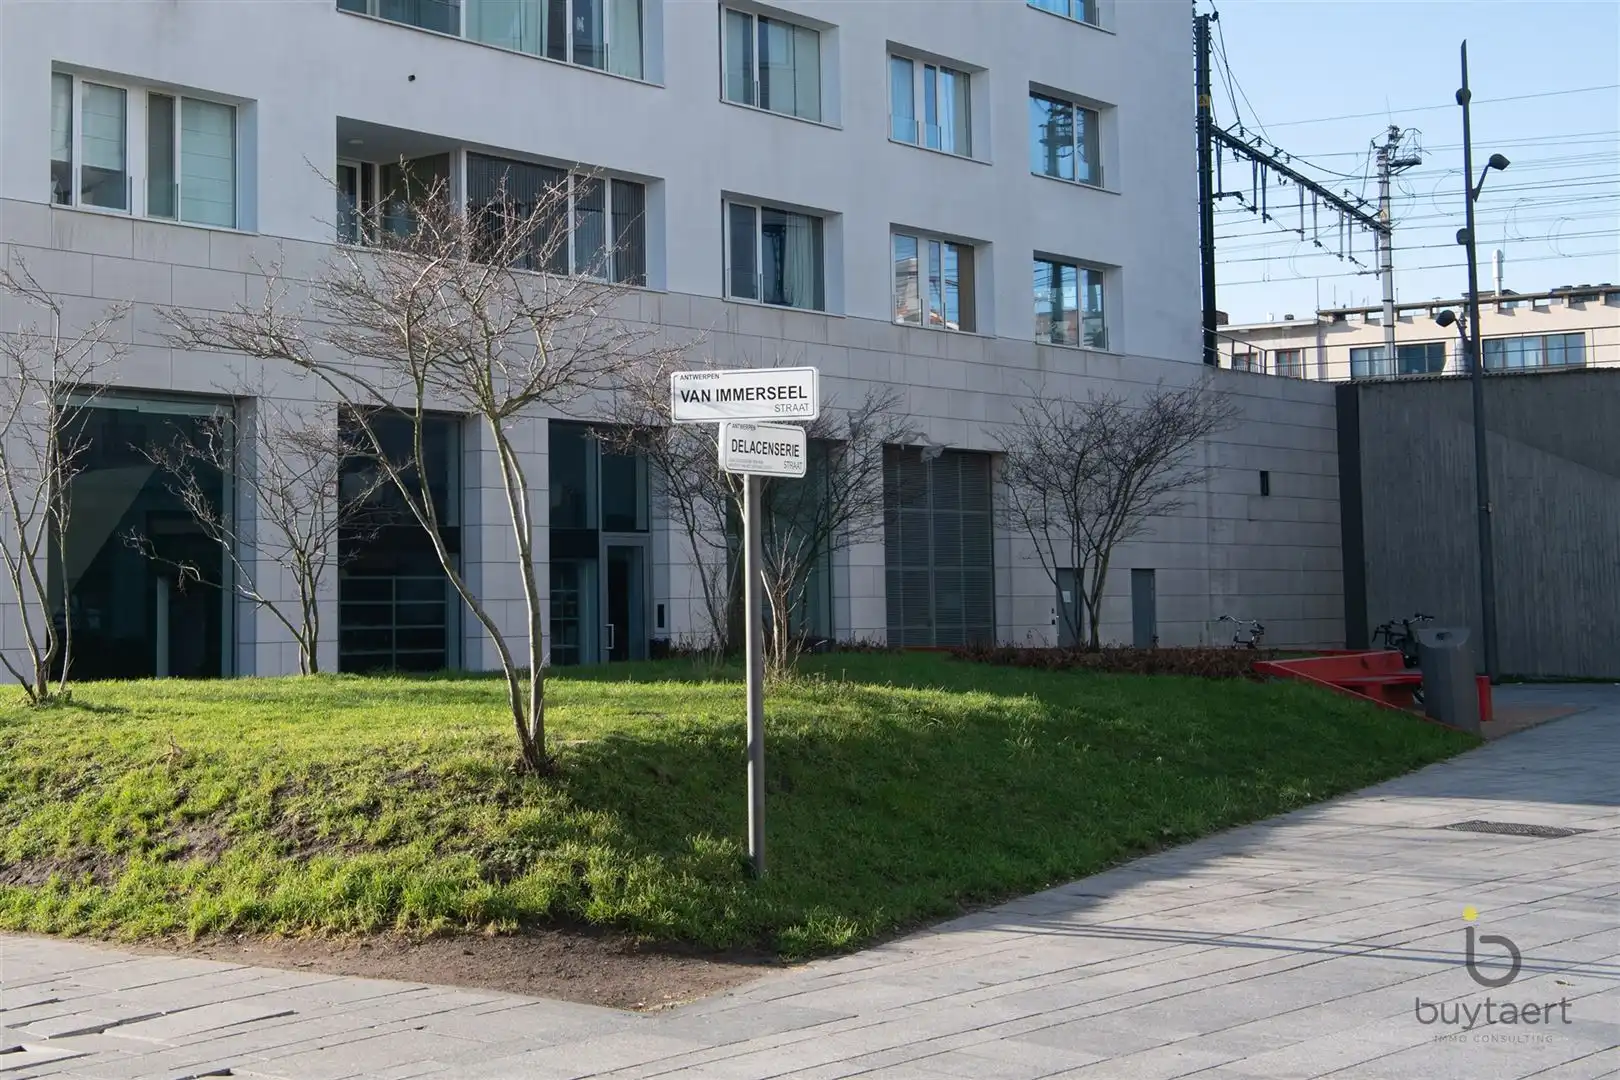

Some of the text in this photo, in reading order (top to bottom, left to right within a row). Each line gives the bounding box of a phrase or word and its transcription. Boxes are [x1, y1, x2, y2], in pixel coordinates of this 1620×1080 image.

[679, 373, 720, 381] ANTWERPEN
[680, 385, 808, 403] VAN IMMERSEEL
[774, 403, 809, 413] STRAAT
[731, 423, 757, 431] ANTWERPEN
[731, 438, 800, 457] DELACENSERIE
[783, 460, 803, 470] STRAAT
